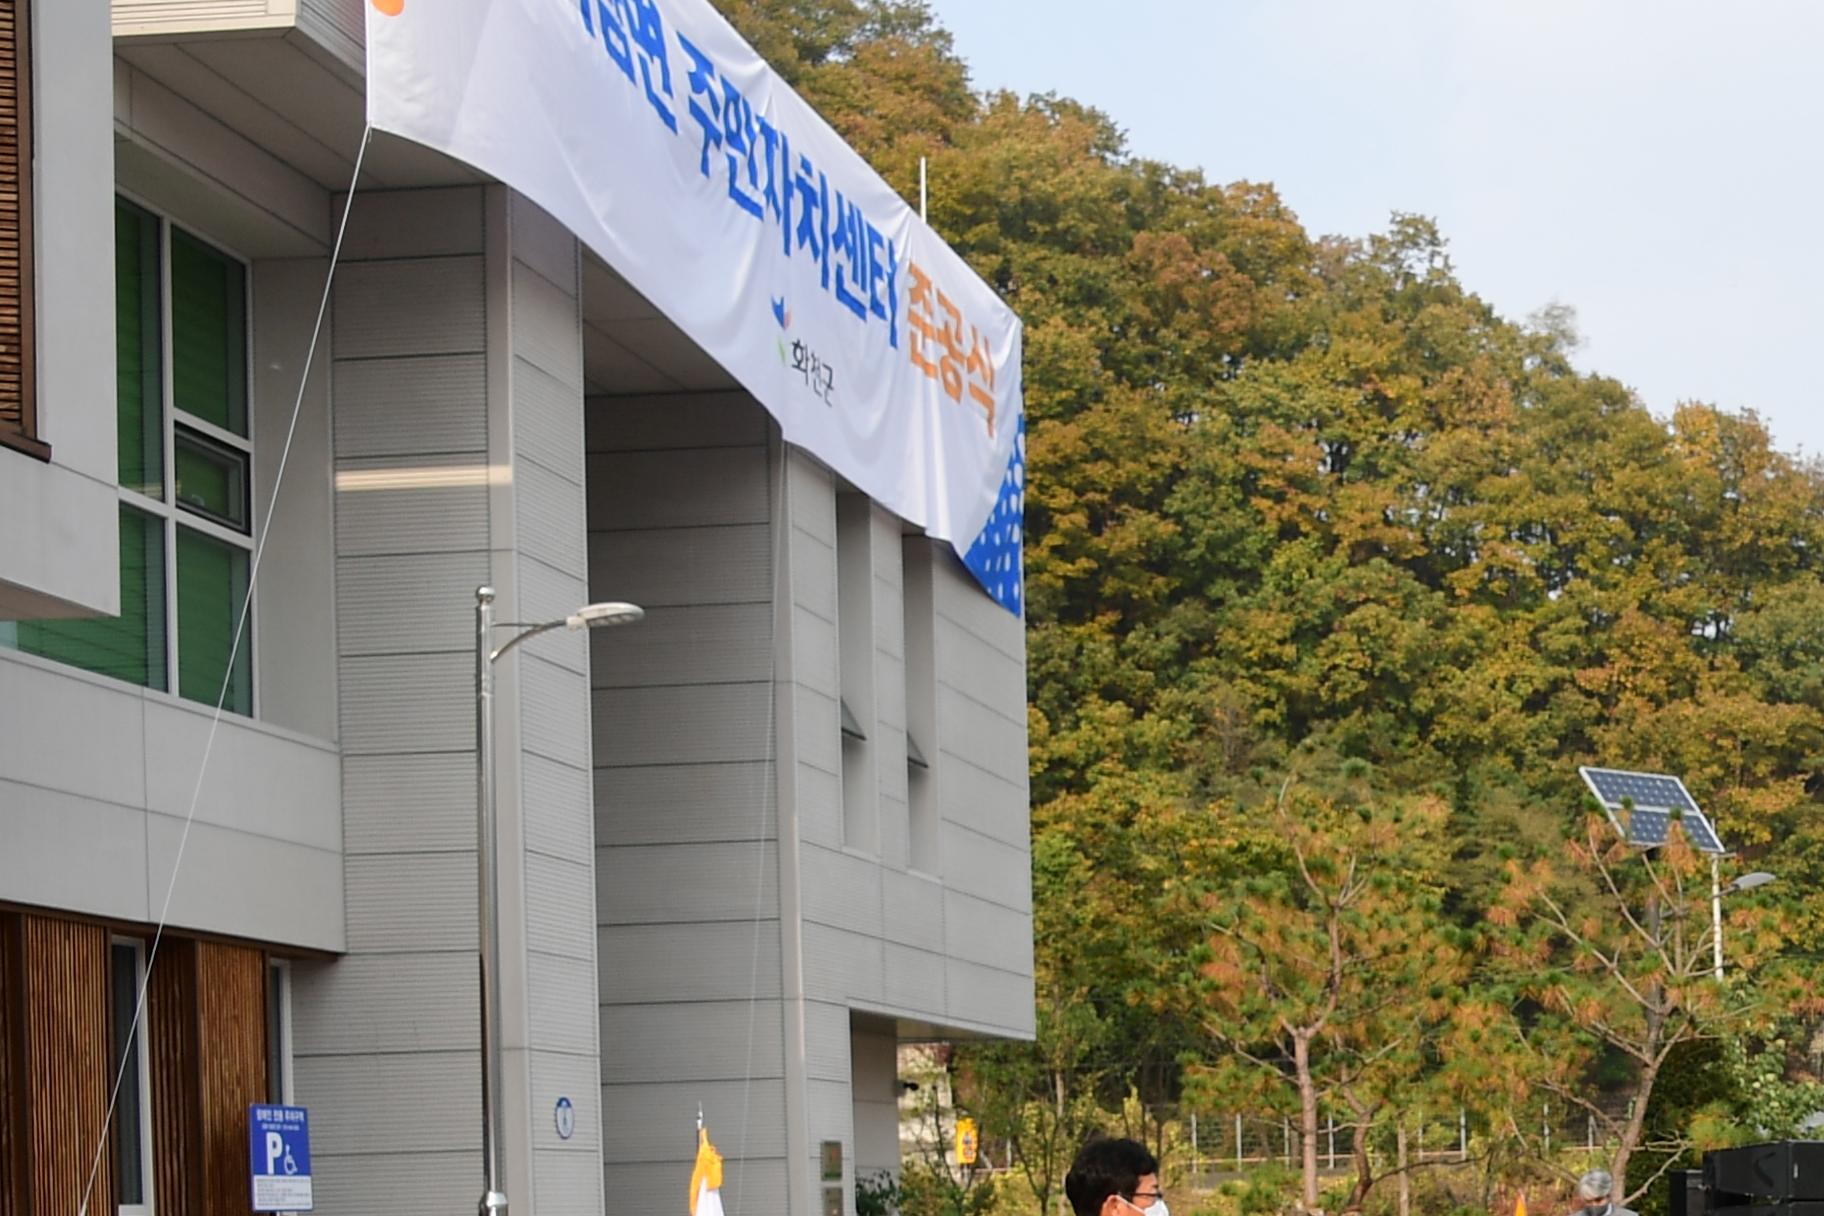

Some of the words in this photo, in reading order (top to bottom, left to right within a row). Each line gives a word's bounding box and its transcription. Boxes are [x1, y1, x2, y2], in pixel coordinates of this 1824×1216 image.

[677, 32, 898, 349] 주민자치센터
[908, 262, 995, 438] 준공식
[792, 339, 834, 408] 화천군
[266, 1132, 283, 1175] P
